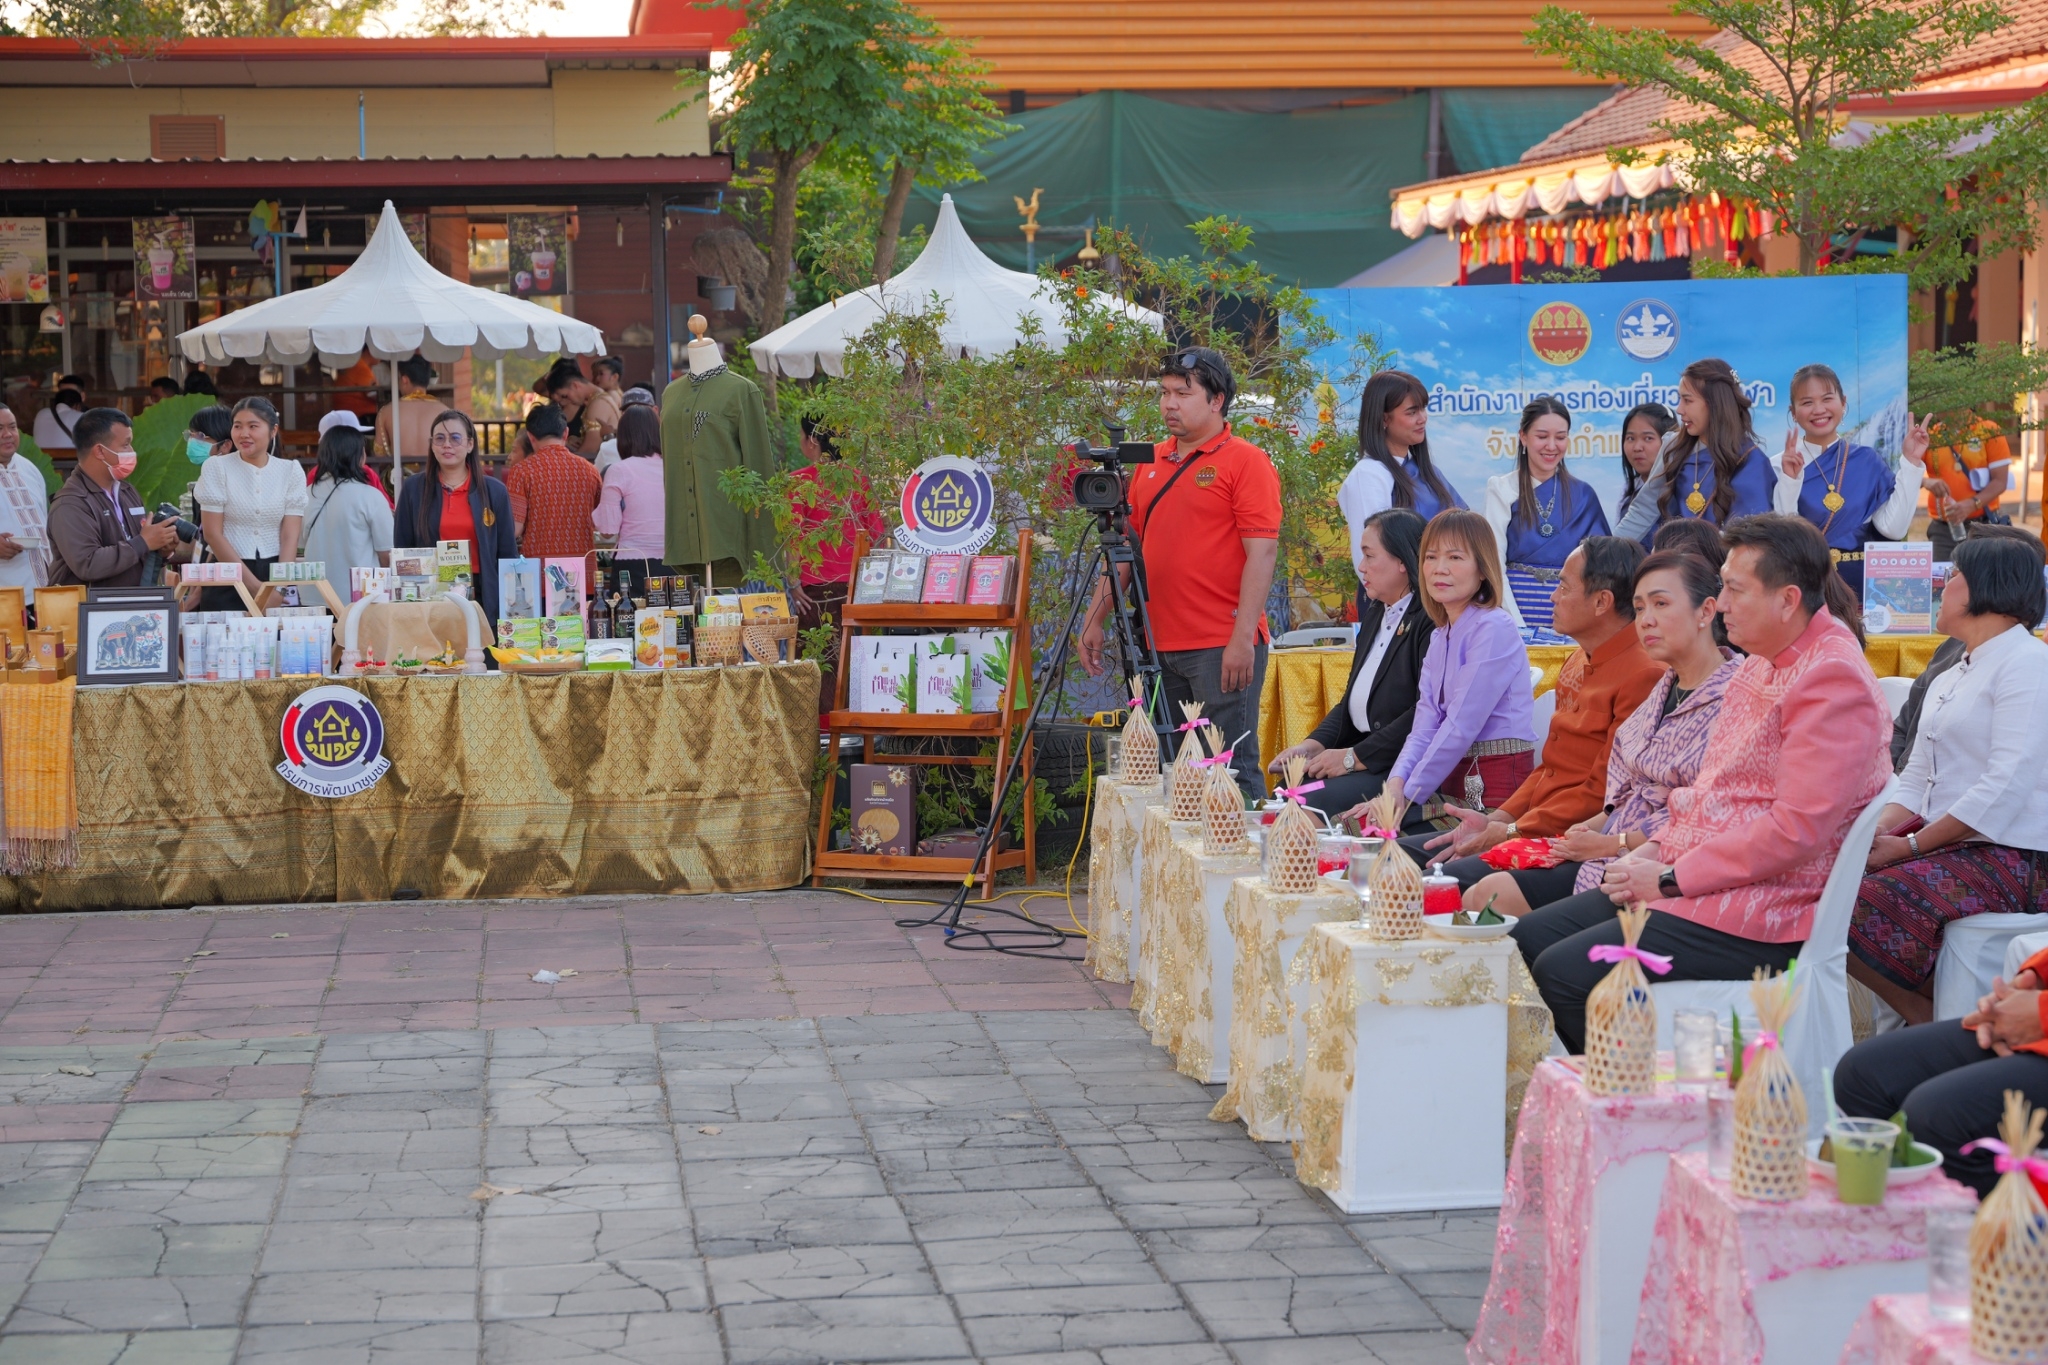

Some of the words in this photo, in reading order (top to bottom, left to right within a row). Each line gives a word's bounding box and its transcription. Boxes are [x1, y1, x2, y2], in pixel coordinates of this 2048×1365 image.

[278, 759, 390, 796] กรมการพัฒนาชุมชน
